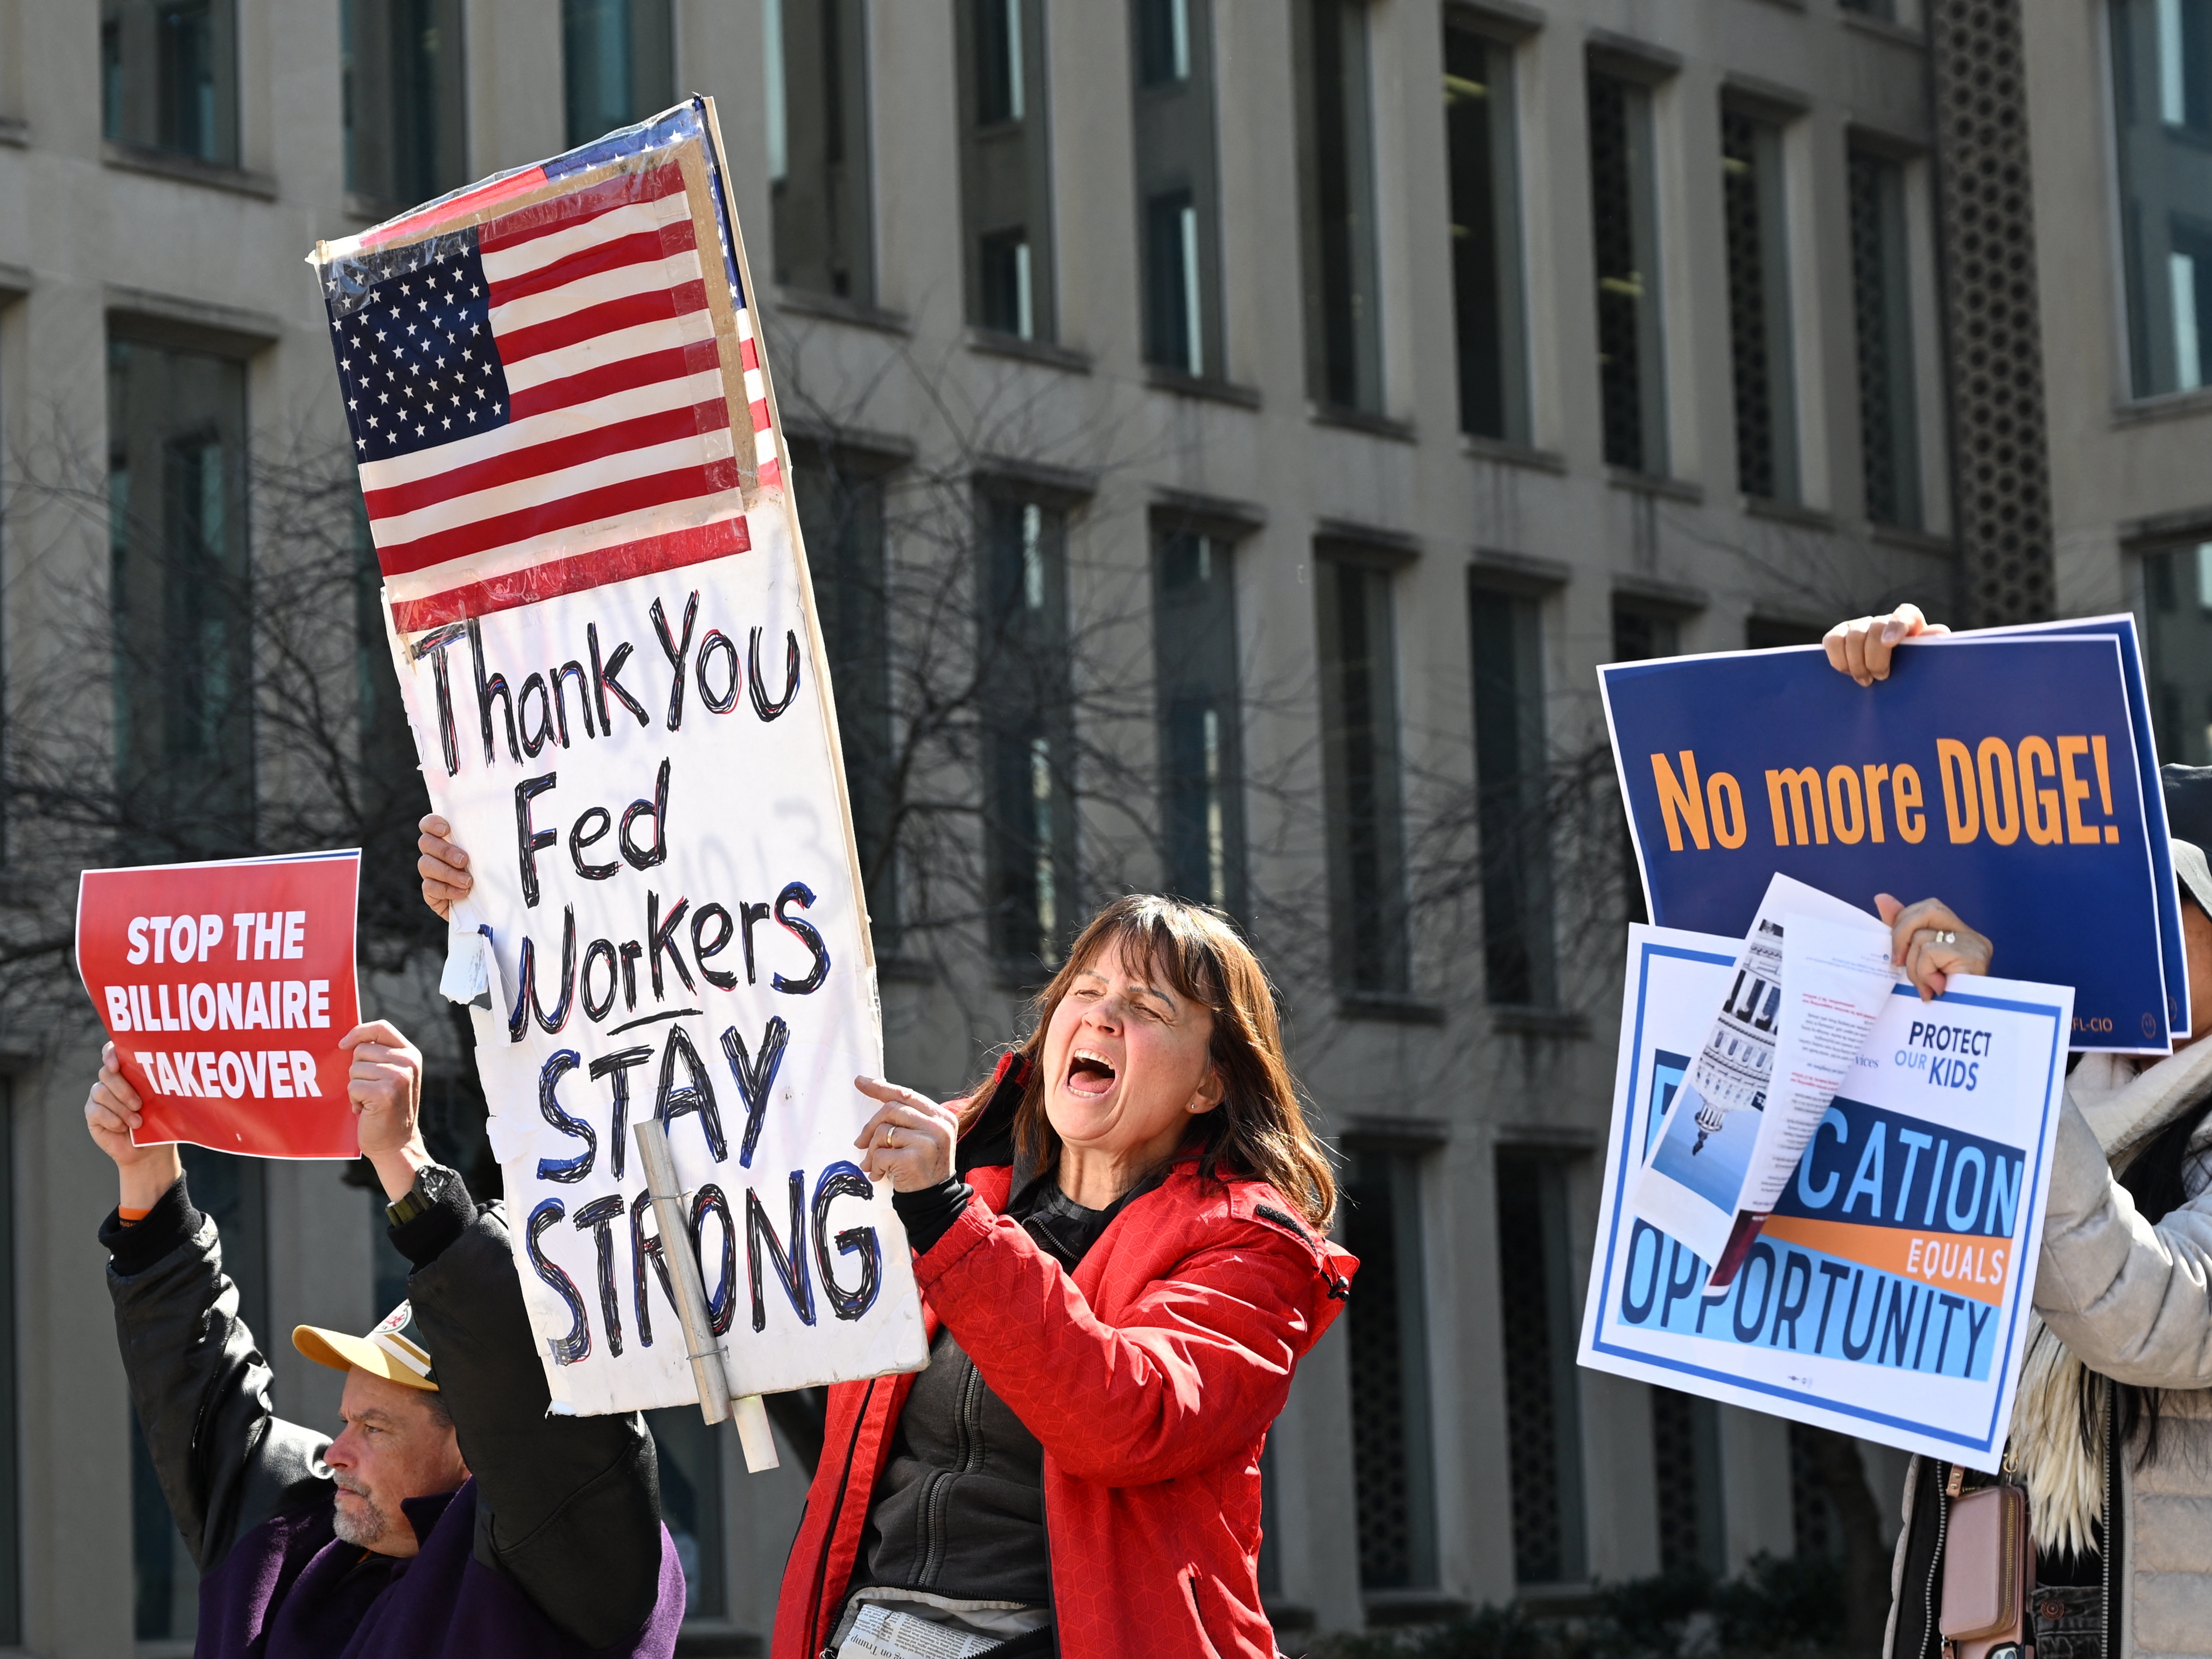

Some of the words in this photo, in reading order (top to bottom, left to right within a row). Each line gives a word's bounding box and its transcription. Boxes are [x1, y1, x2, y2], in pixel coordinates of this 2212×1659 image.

[408, 617, 650, 777] Thank
[650, 589, 800, 732] You
[1651, 750, 1748, 852] No
[1764, 762, 1927, 846] more
[1936, 734, 2120, 845] DOGE!
[514, 757, 671, 909] Fed
[126, 914, 223, 965] STOP
[233, 911, 306, 961] THE
[478, 881, 832, 1043] Workers
[104, 979, 331, 1032] BILLIONAIRE
[2071, 1017, 2113, 1032] FL-CIO
[1908, 1021, 1992, 1057] PROTECT
[134, 1050, 323, 1099] TAKEOVER
[1894, 1050, 1927, 1070] OUR
[1928, 1056, 1979, 1092] KIDS
[537, 1016, 790, 1183] STAY
[526, 1160, 882, 1366] STRONG
[1906, 1238, 2003, 1286] EQUALS
[850, 1634, 877, 1656] Trump
[880, 1648, 892, 1658] on
